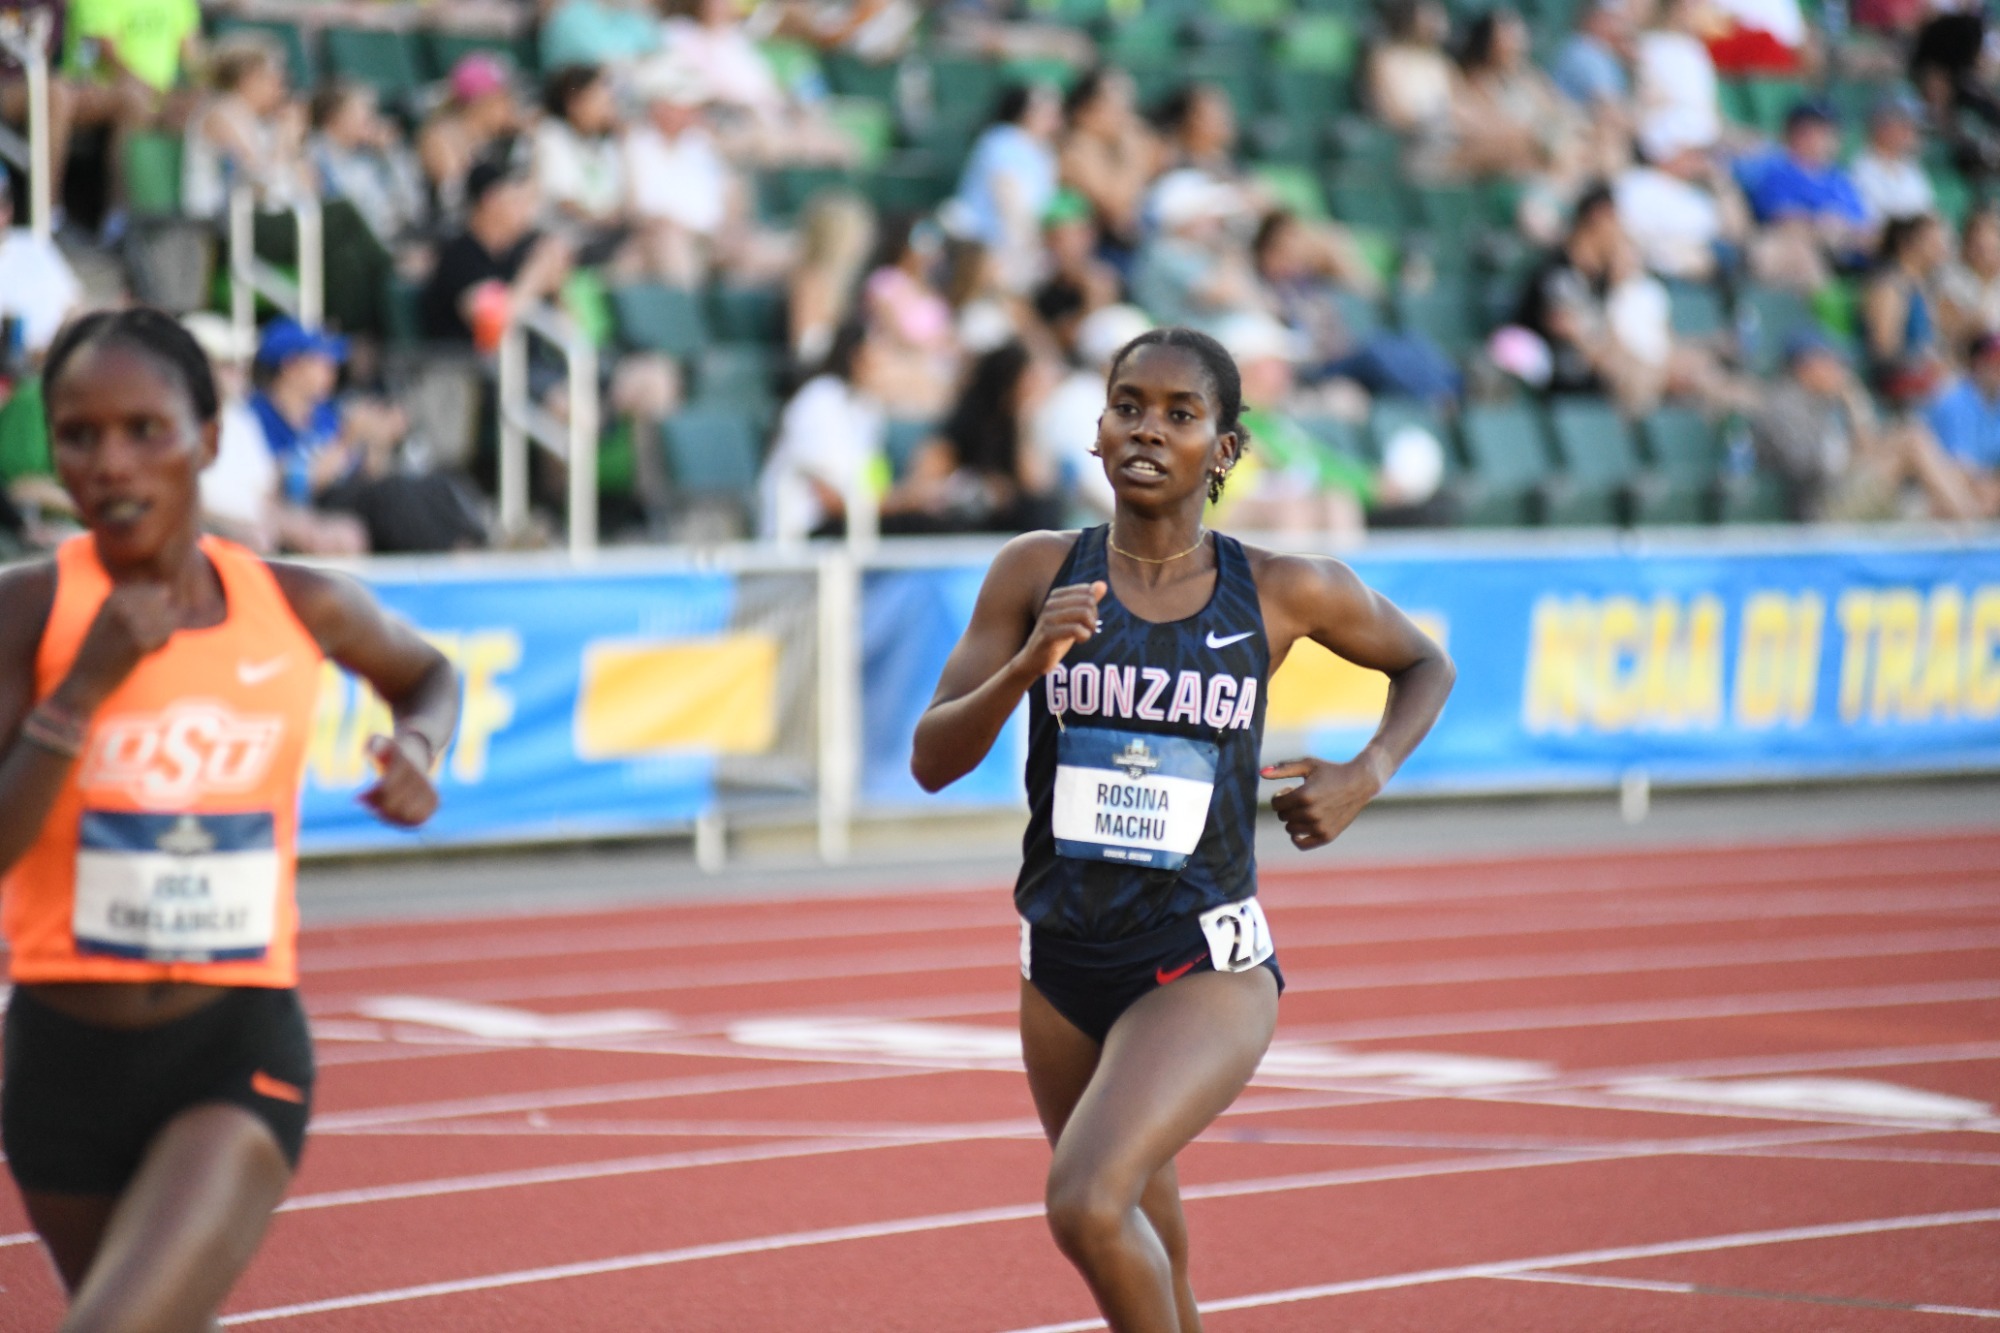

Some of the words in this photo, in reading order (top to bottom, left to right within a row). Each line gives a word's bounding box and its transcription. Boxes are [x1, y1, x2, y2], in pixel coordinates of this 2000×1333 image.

[1525, 594, 1724, 733] NCAA
[1736, 591, 1825, 729] DI
[1046, 663, 1257, 730] GONZAGA
[82, 700, 282, 808] OSU
[1095, 813, 1166, 840] MACHU
[1097, 783, 1169, 811] ROSINA
